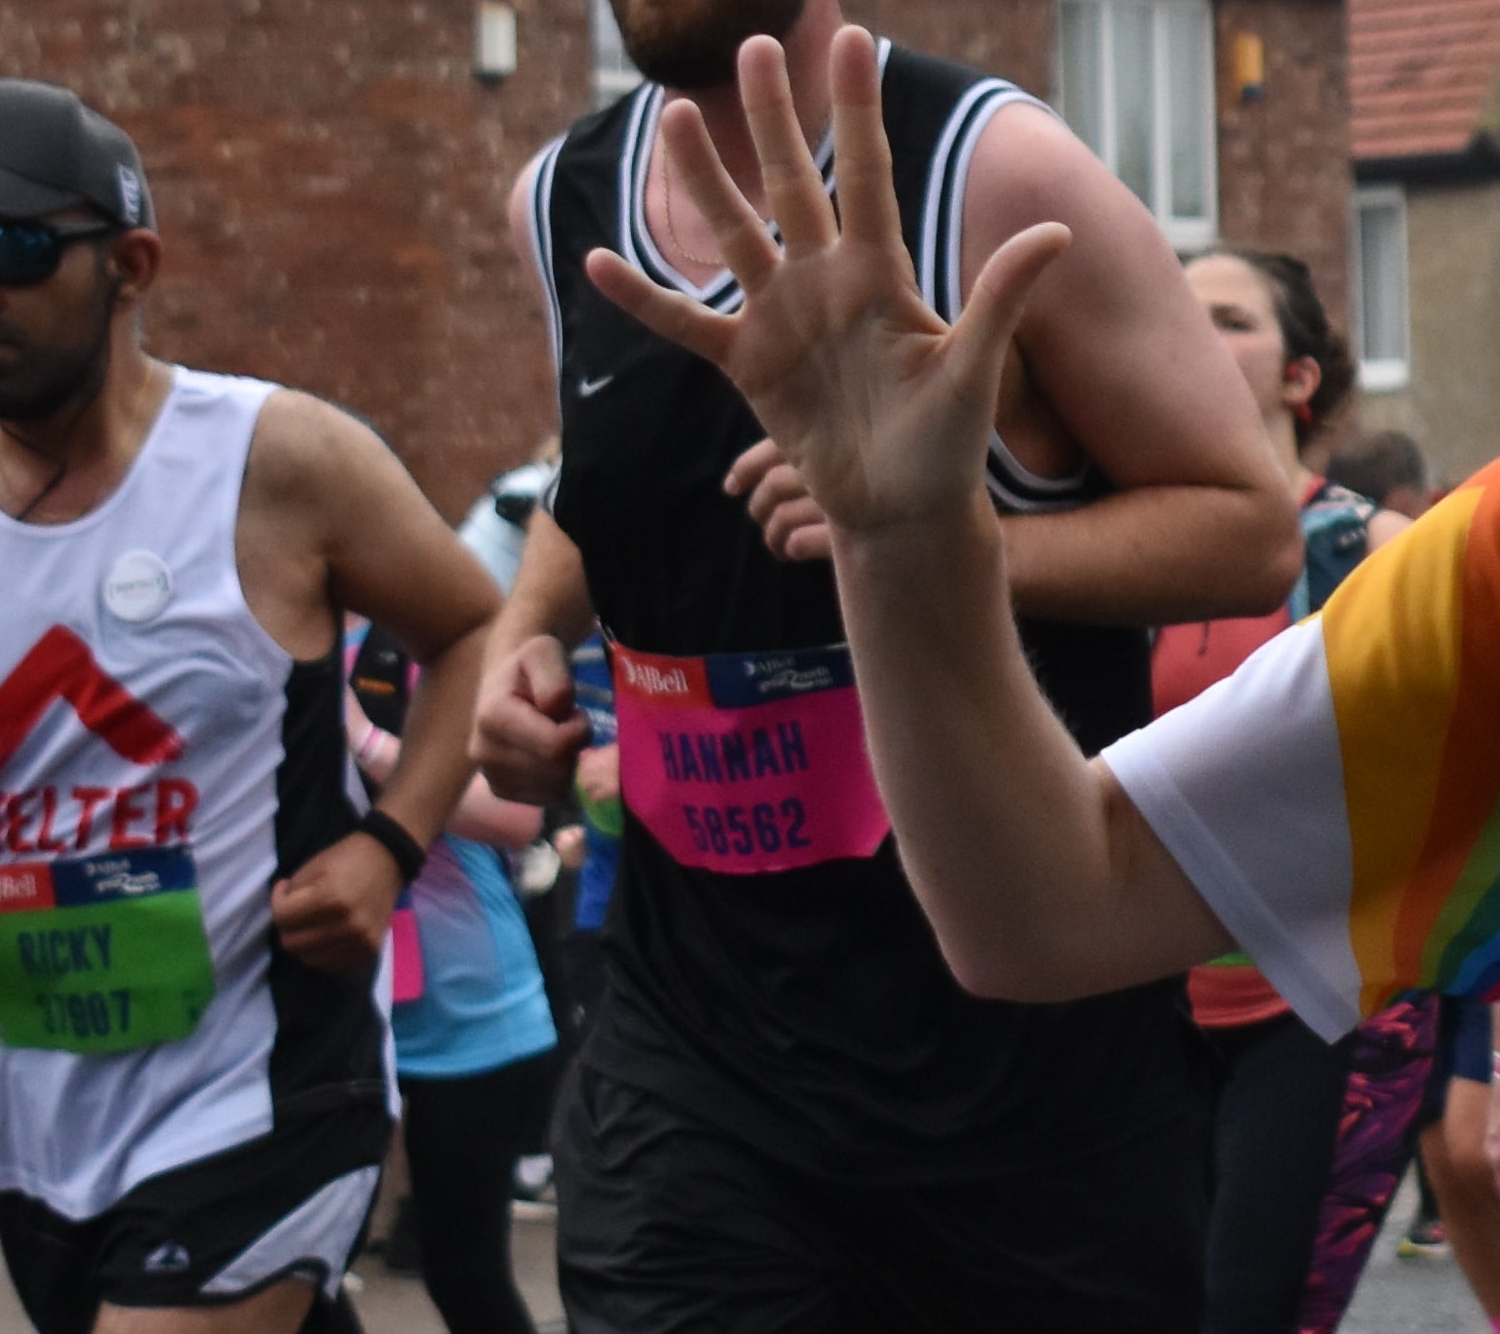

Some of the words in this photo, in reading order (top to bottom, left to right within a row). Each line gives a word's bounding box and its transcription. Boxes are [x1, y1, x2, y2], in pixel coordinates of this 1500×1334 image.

[659, 719, 810, 784] HANNAH
[683, 797, 813, 856] 58562
[16, 923, 113, 976] RICKY
